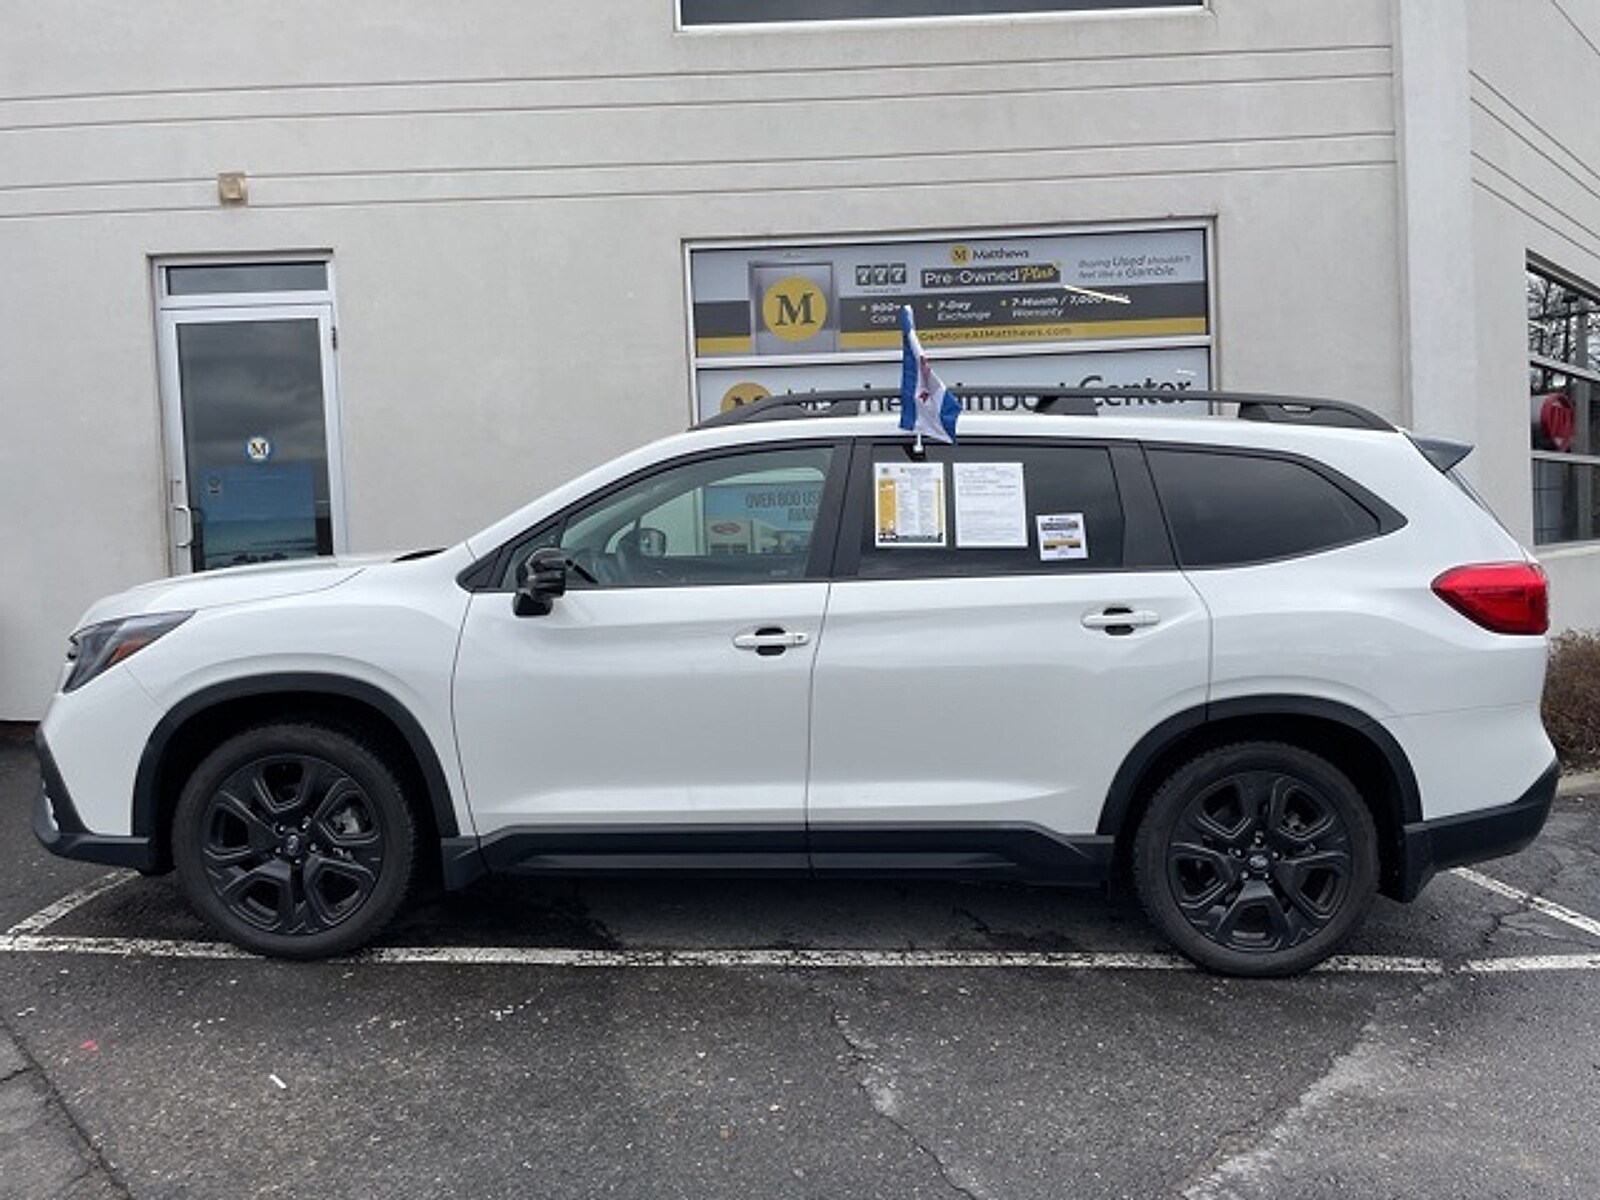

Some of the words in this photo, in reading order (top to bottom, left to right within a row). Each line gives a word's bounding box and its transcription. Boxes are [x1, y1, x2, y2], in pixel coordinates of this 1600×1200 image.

[972, 247, 1029, 260] Matthews
[1078, 258, 1111, 269] Buying
[1112, 255, 1145, 267] Used
[924, 267, 1019, 285] Pre-Owned
[1020, 266, 1057, 282] Plus
[775, 292, 816, 326] M
[937, 299, 972, 311] 7-Day
[870, 313, 897, 324] Cars
[937, 310, 991, 321] Exchange
[1012, 307, 1064, 318] Warranty
[745, 492, 776, 509] OVER
